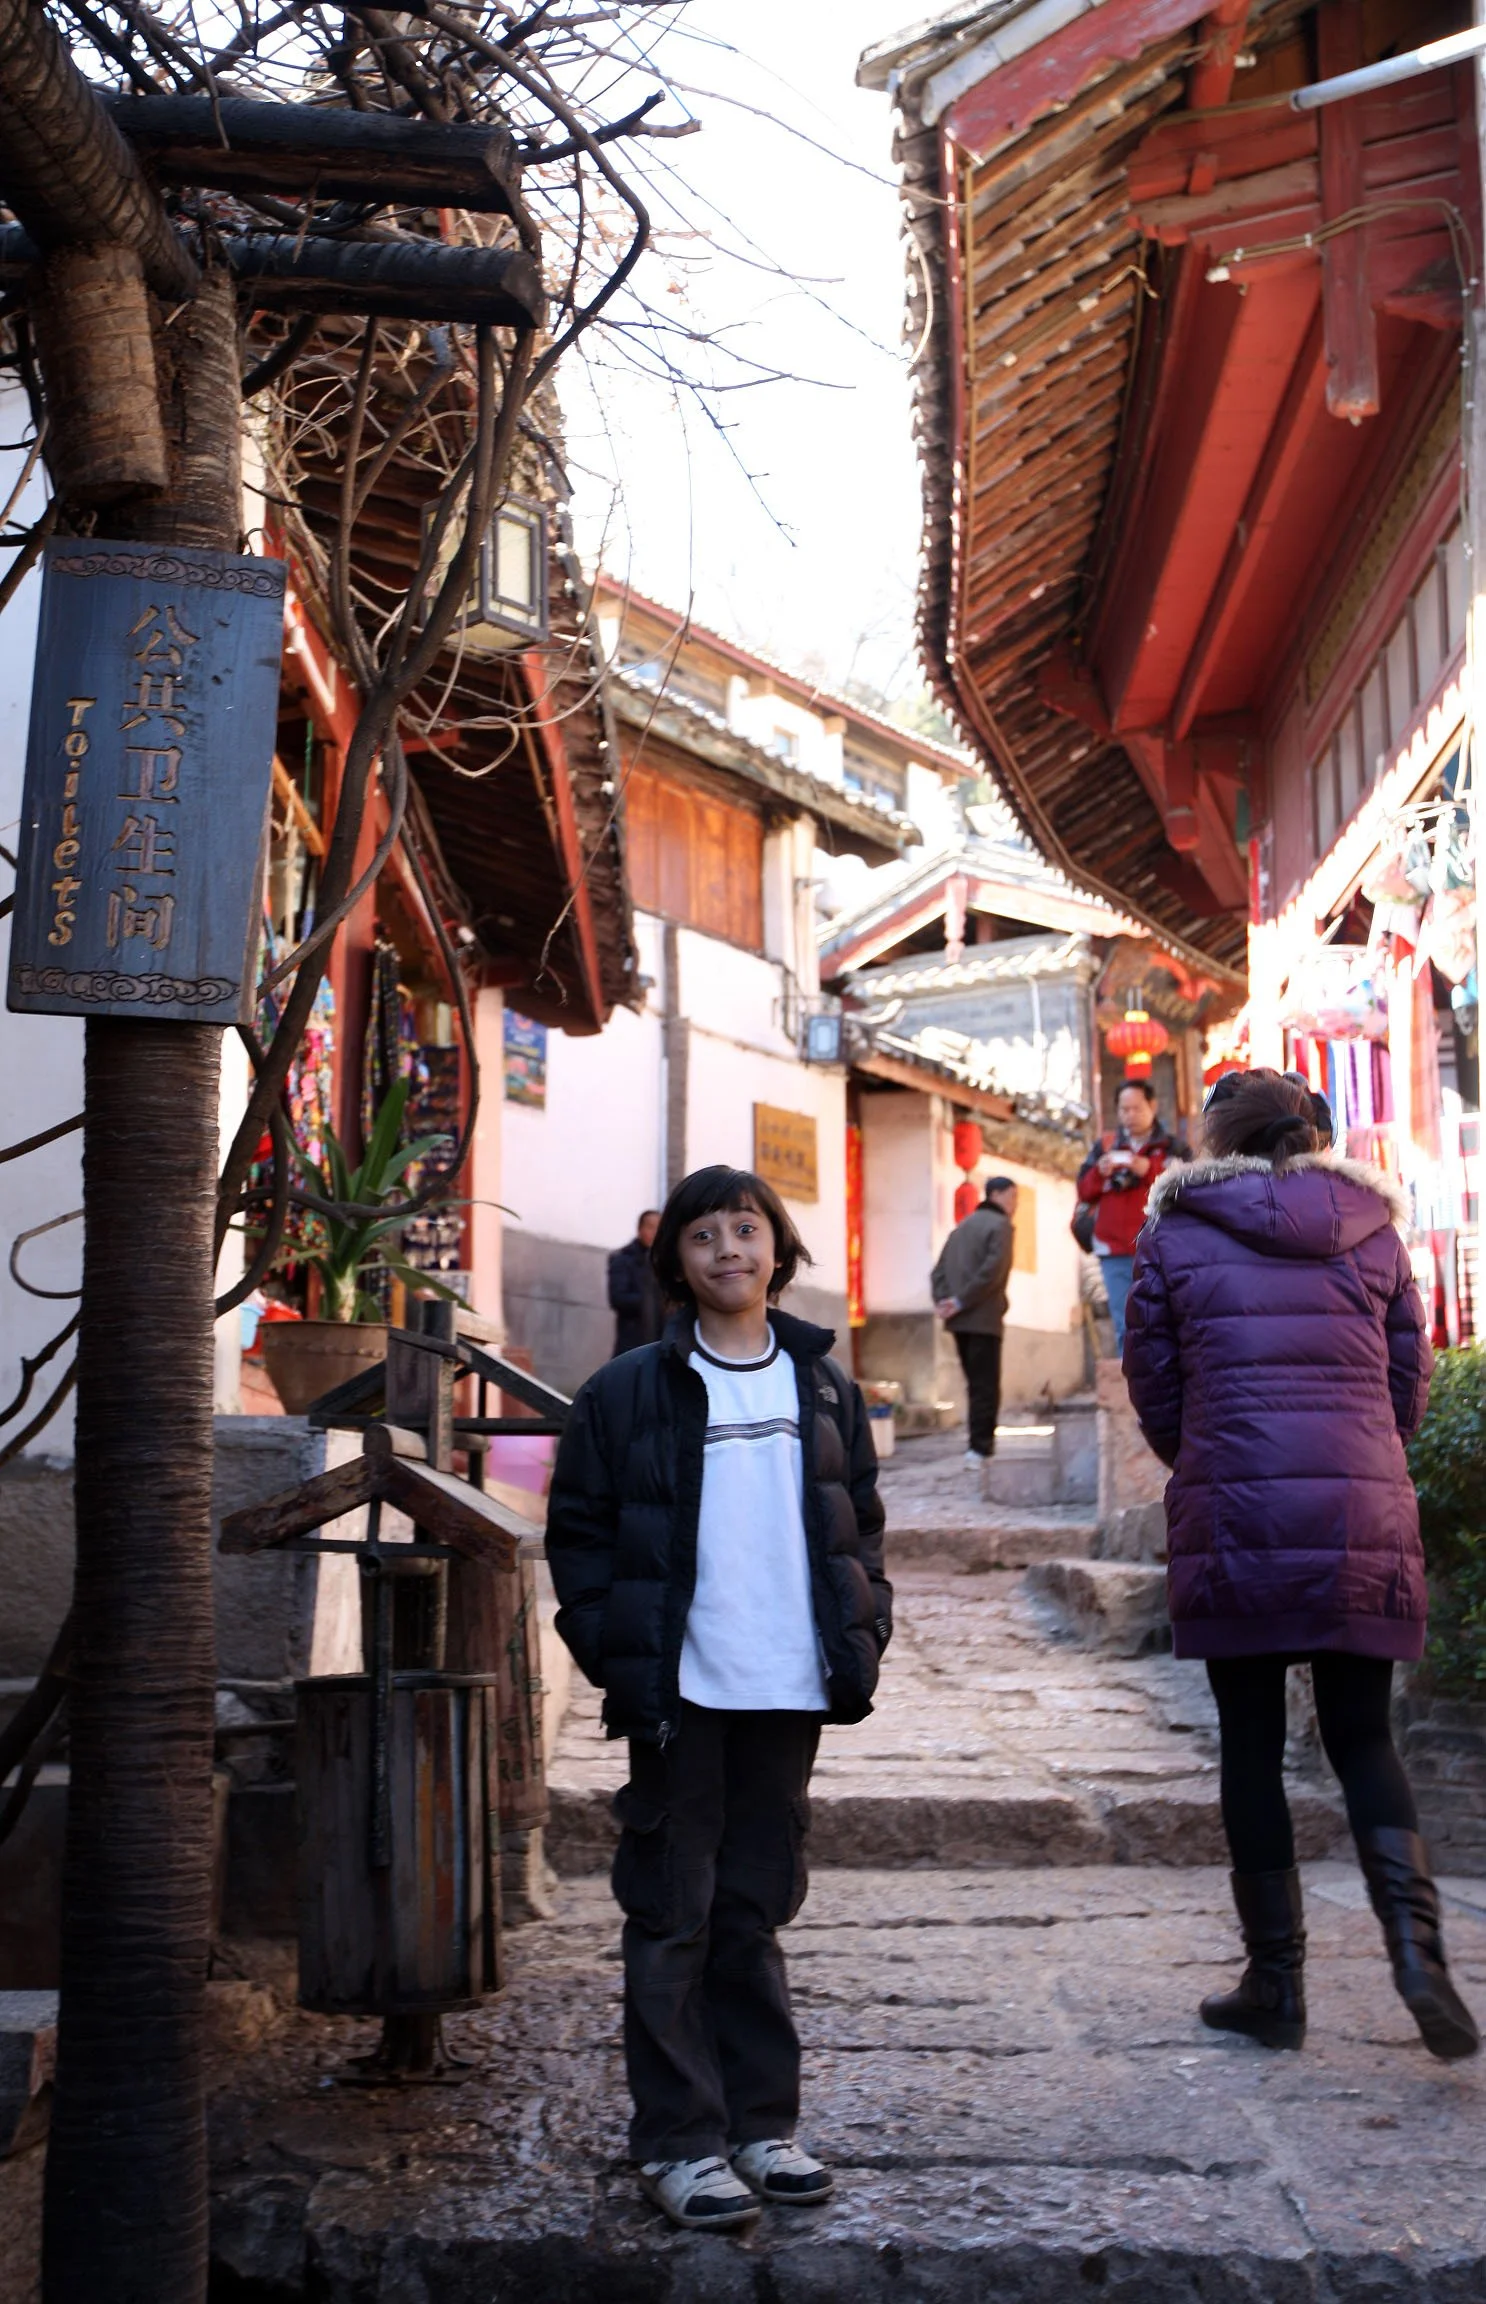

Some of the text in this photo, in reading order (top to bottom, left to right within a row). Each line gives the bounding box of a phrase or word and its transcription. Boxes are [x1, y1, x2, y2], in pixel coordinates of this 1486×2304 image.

[48, 697, 96, 946] Toilets
[107, 605, 200, 951] 公共卫生间
